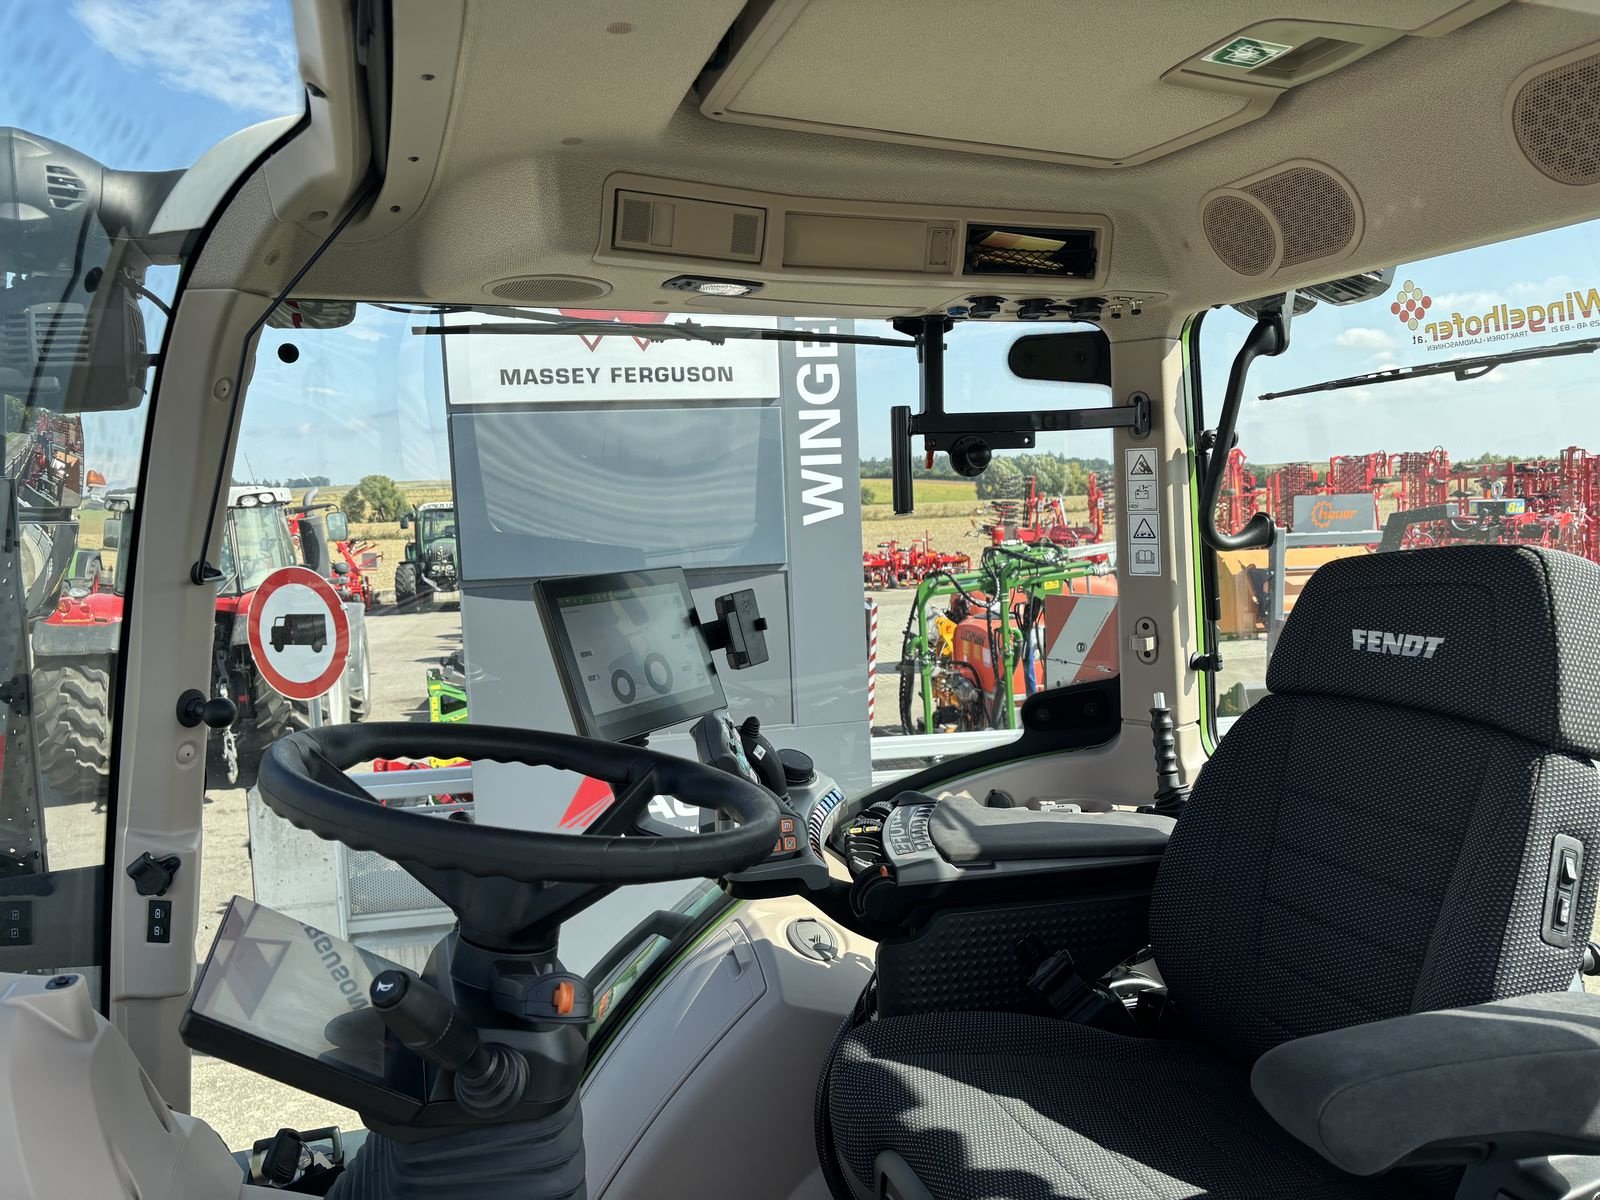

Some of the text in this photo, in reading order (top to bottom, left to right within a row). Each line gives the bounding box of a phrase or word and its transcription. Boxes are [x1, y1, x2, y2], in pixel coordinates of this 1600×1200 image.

[500, 365, 734, 386] MASSEY FERGUSON
[794, 317, 844, 526] WINGE
[1351, 628, 1446, 660] FENDT
